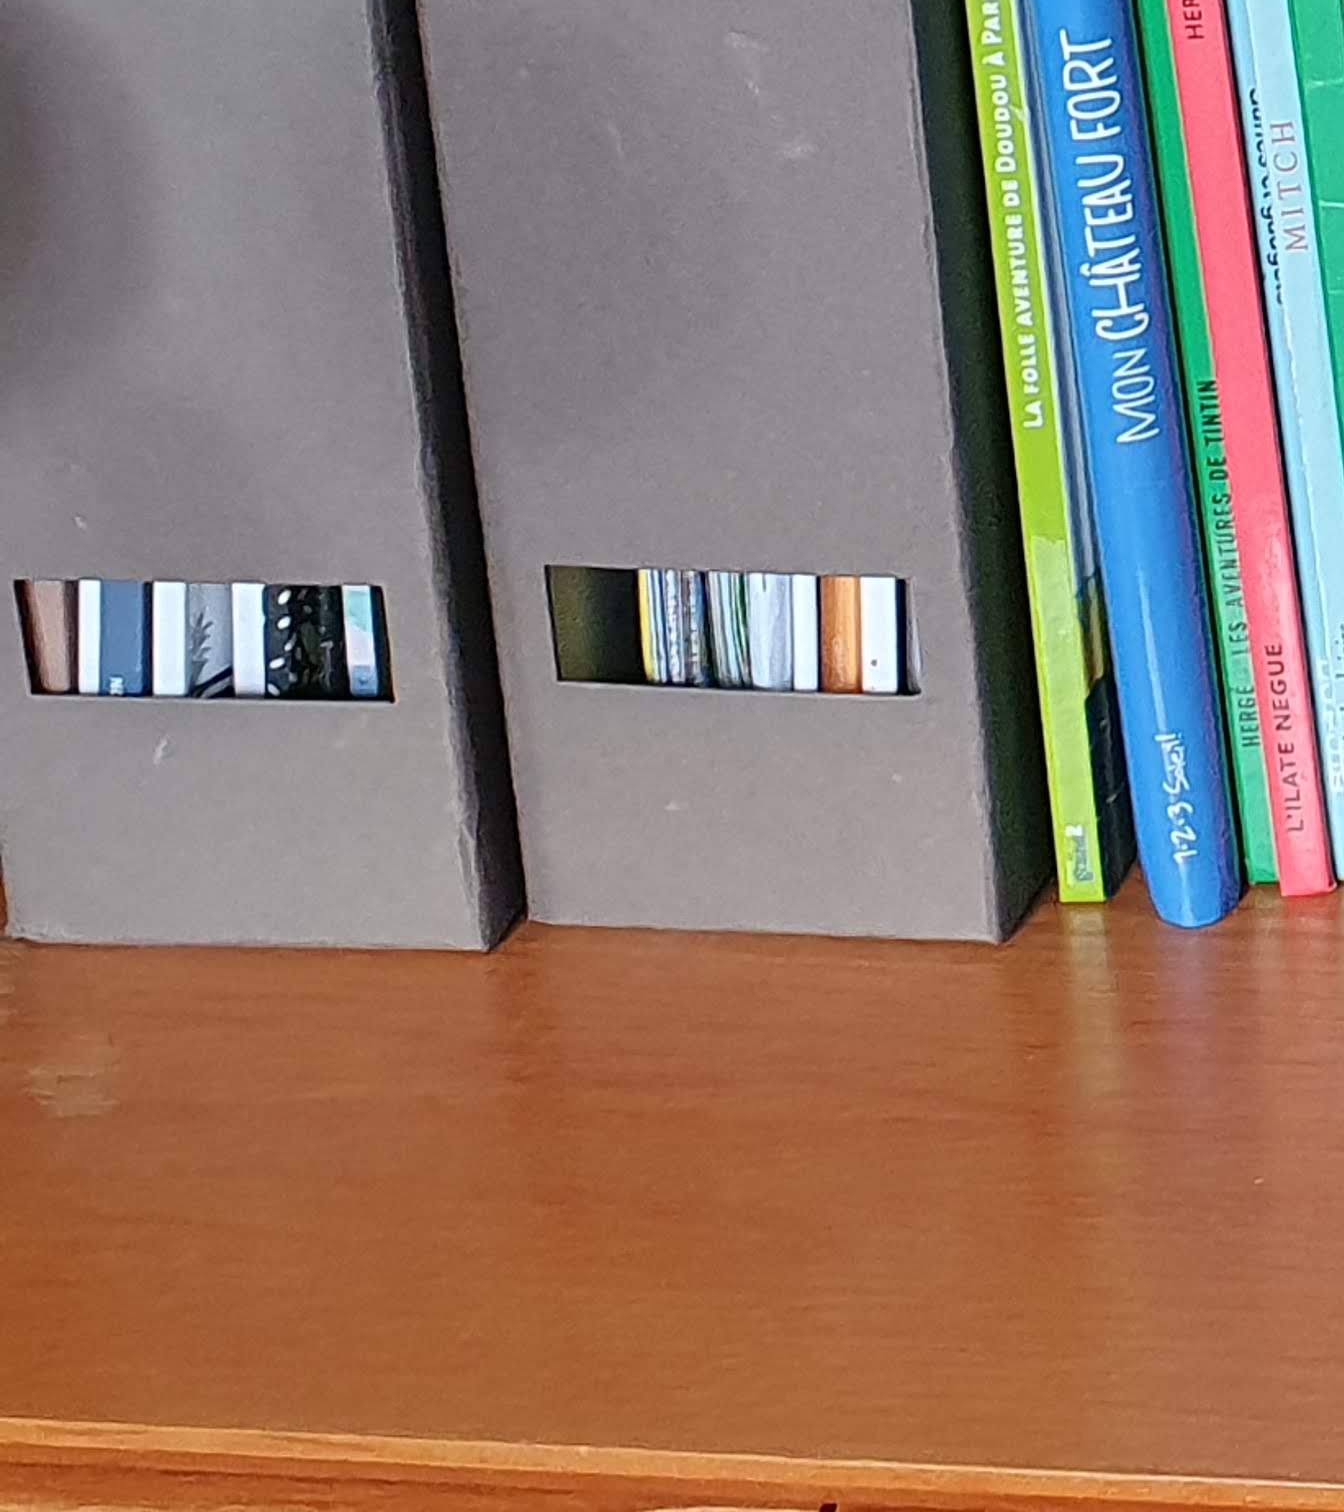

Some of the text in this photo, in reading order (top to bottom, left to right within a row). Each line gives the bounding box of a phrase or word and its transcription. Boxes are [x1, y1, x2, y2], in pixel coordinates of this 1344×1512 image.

[984, 73, 1017, 174] DOUDOU
[1057, 24, 1161, 443] MON CHÂTEAU FORT
[1268, 120, 1307, 252] MITCH
[1003, 214, 1033, 326] AVENTURE
[1016, 333, 1041, 394] FOLLE
[1021, 401, 1044, 428] LA
[1264, 642, 1291, 732] NEGUE
